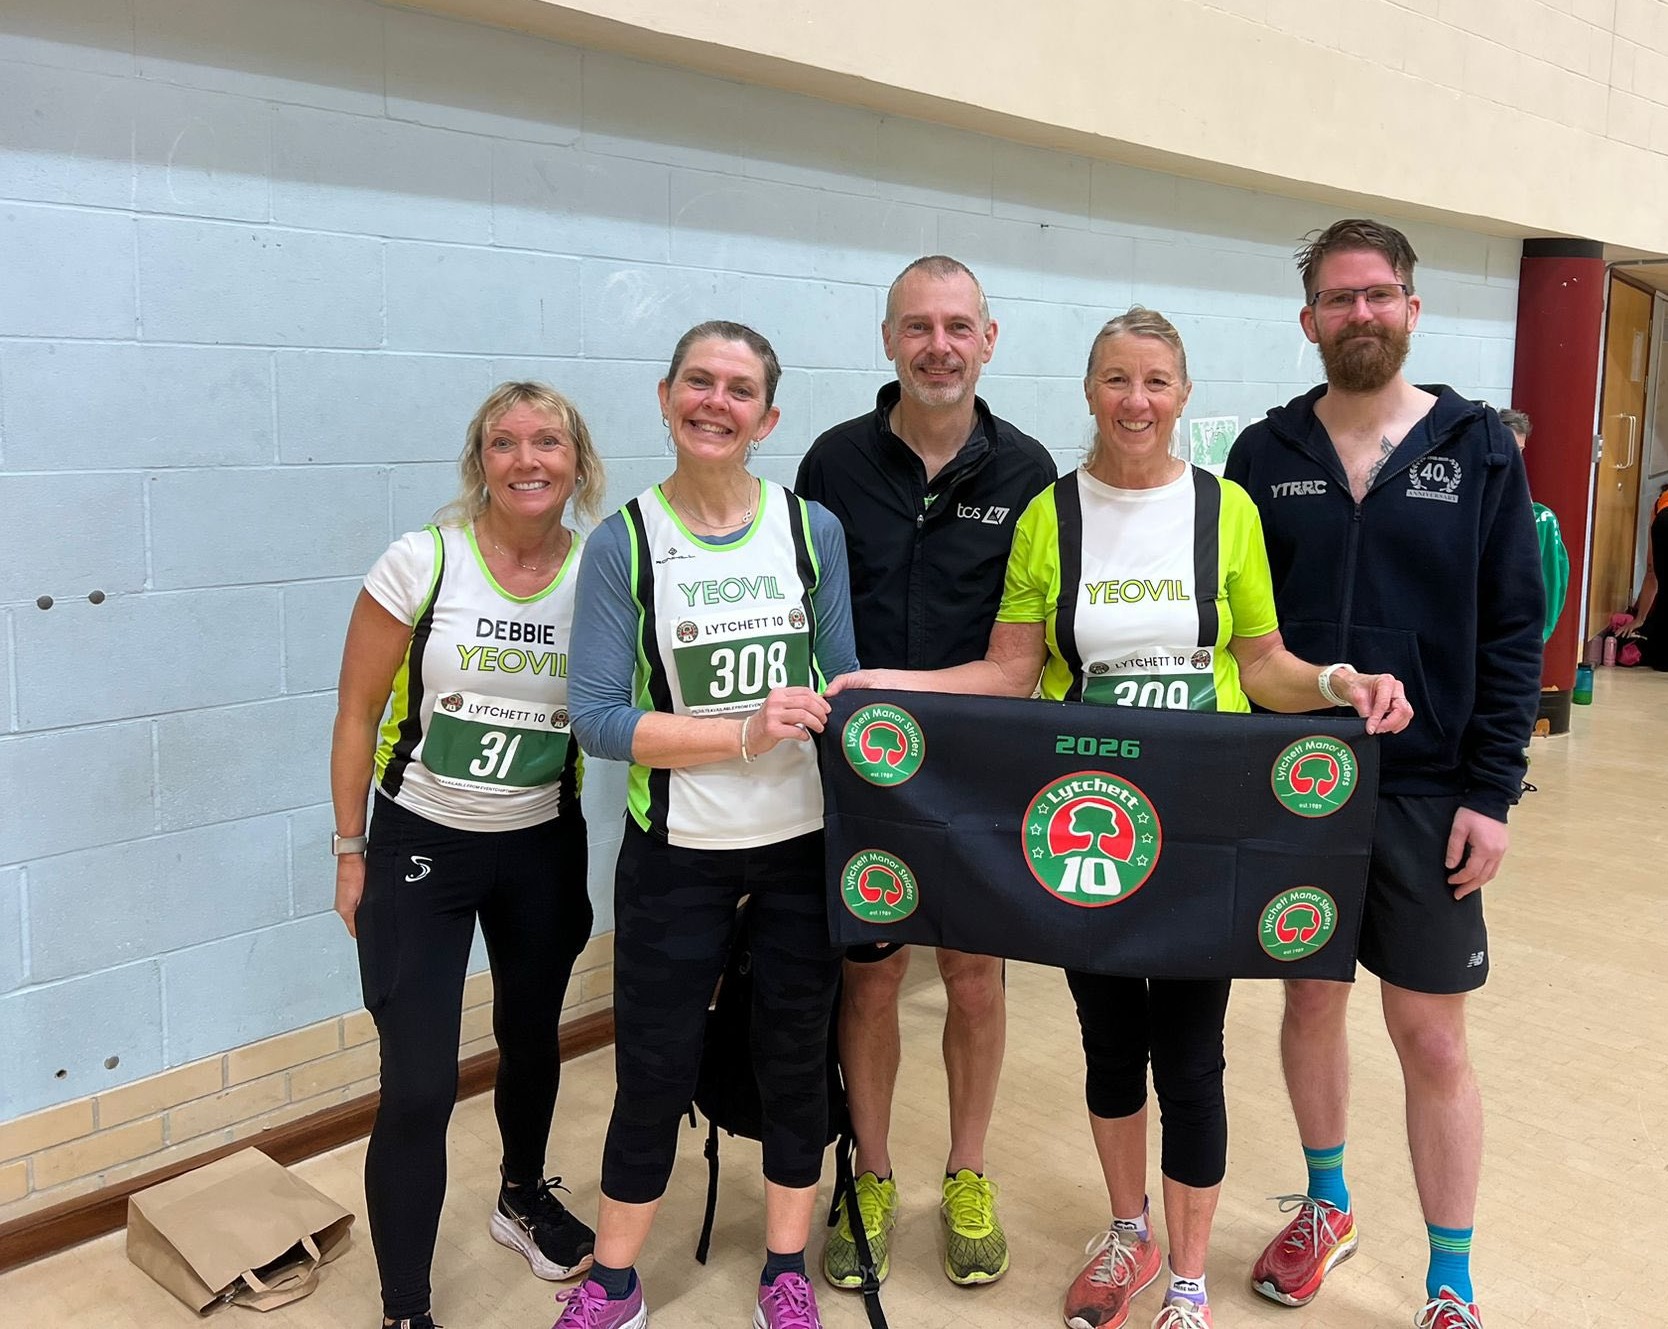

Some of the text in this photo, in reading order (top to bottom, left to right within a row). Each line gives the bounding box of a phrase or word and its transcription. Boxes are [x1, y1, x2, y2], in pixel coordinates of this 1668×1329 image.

[1270, 480, 1328, 498] YTRRC
[956, 502, 981, 520] tcs
[678, 576, 786, 607] YEOVIL
[1085, 579, 1190, 604] YEOVIL
[476, 617, 555, 645] DEBBIE
[705, 617, 769, 636] LYTCHETT
[772, 616, 784, 627] 10
[456, 644, 568, 678] YEOVIL
[709, 640, 788, 699] 308
[1115, 656, 1185, 668] LYTCHETT 10
[468, 704, 546, 724] LYTCHETT 10
[848, 708, 920, 757] Lytchett Manor Striders
[1056, 735, 1140, 758] 2026
[469, 731, 522, 780] 31
[1276, 740, 1352, 786] Lytchett Manor Striders
[1046, 778, 1140, 810] Lytchett
[846, 853, 914, 900] Lytchett Manor Striders
[1056, 856, 1122, 896] 10
[1264, 892, 1333, 933] Lytchett Manor Striders
